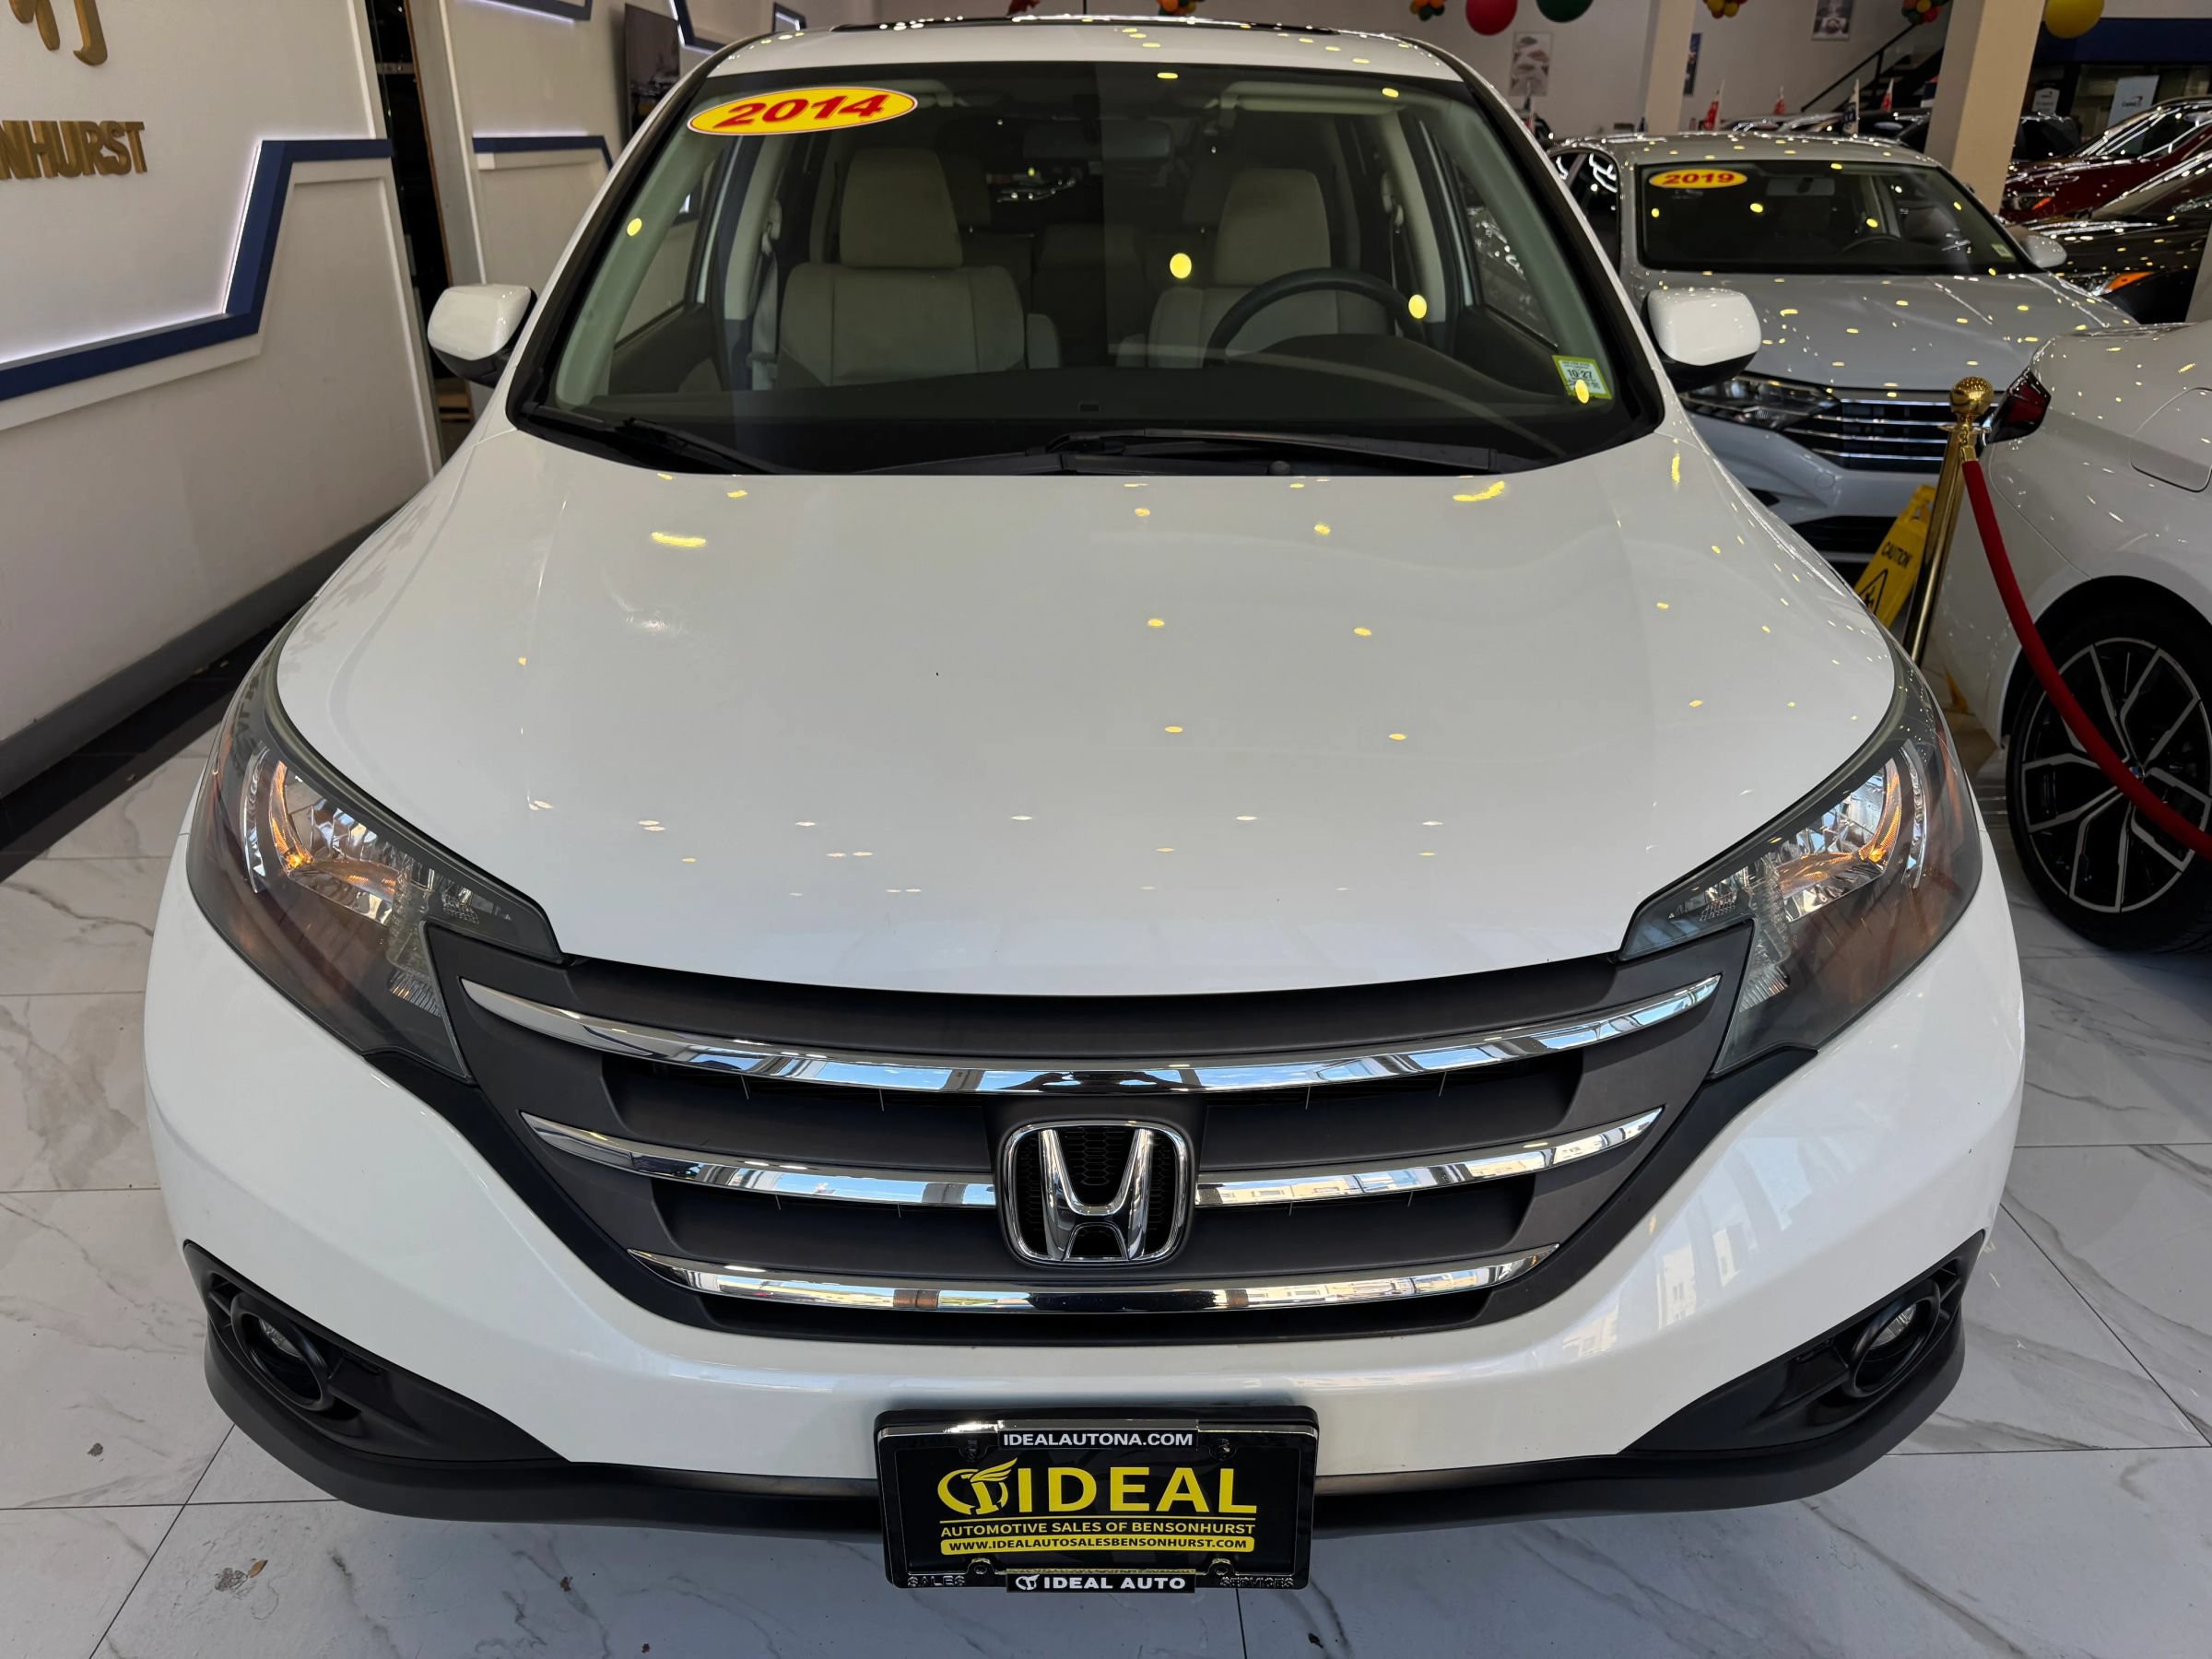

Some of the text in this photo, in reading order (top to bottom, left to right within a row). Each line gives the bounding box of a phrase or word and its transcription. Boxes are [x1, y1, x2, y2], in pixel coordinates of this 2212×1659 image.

[713, 94, 889, 128] 2014
[1662, 172, 1735, 185] 2019
[1004, 1433, 1193, 1446] IDEALAUTONA.COM
[1018, 1466, 1257, 1513] IDEAL
[941, 1522, 1255, 1537] AUTOMOTIVE SALES OF BENSONHURST
[949, 1537, 1247, 1551] WWW.IDEALAUTOSALESBENSONHURST.COM
[1043, 1577, 1186, 1589] IDEAL AUTO
